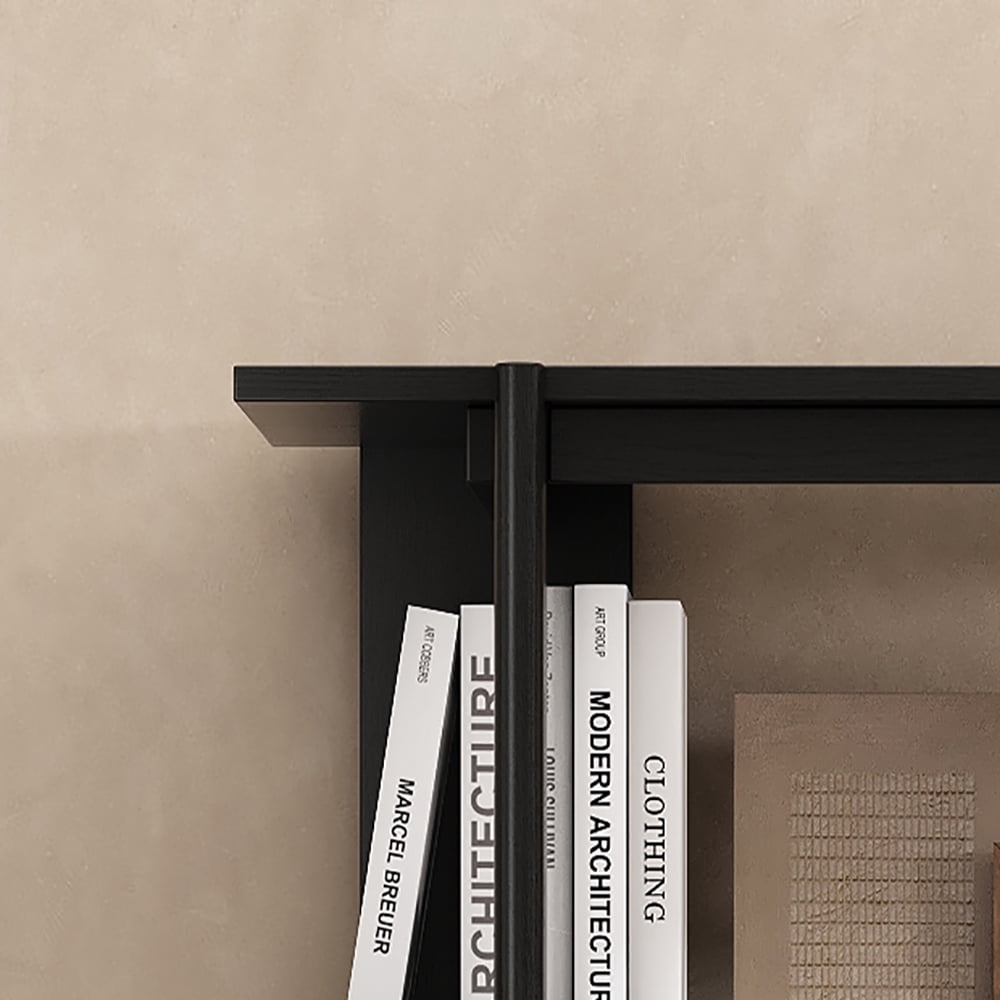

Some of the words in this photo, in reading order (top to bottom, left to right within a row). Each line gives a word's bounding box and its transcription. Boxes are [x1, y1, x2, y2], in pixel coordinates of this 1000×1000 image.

[424, 624, 435, 643] ART
[594, 606, 606, 625] ART
[594, 626, 606, 658] GROUP
[589, 690, 612, 808] MODERN
[387, 778, 415, 864] MARCEL
[643, 754, 666, 924] CLOTHING
[373, 869, 401, 955] BREUER
